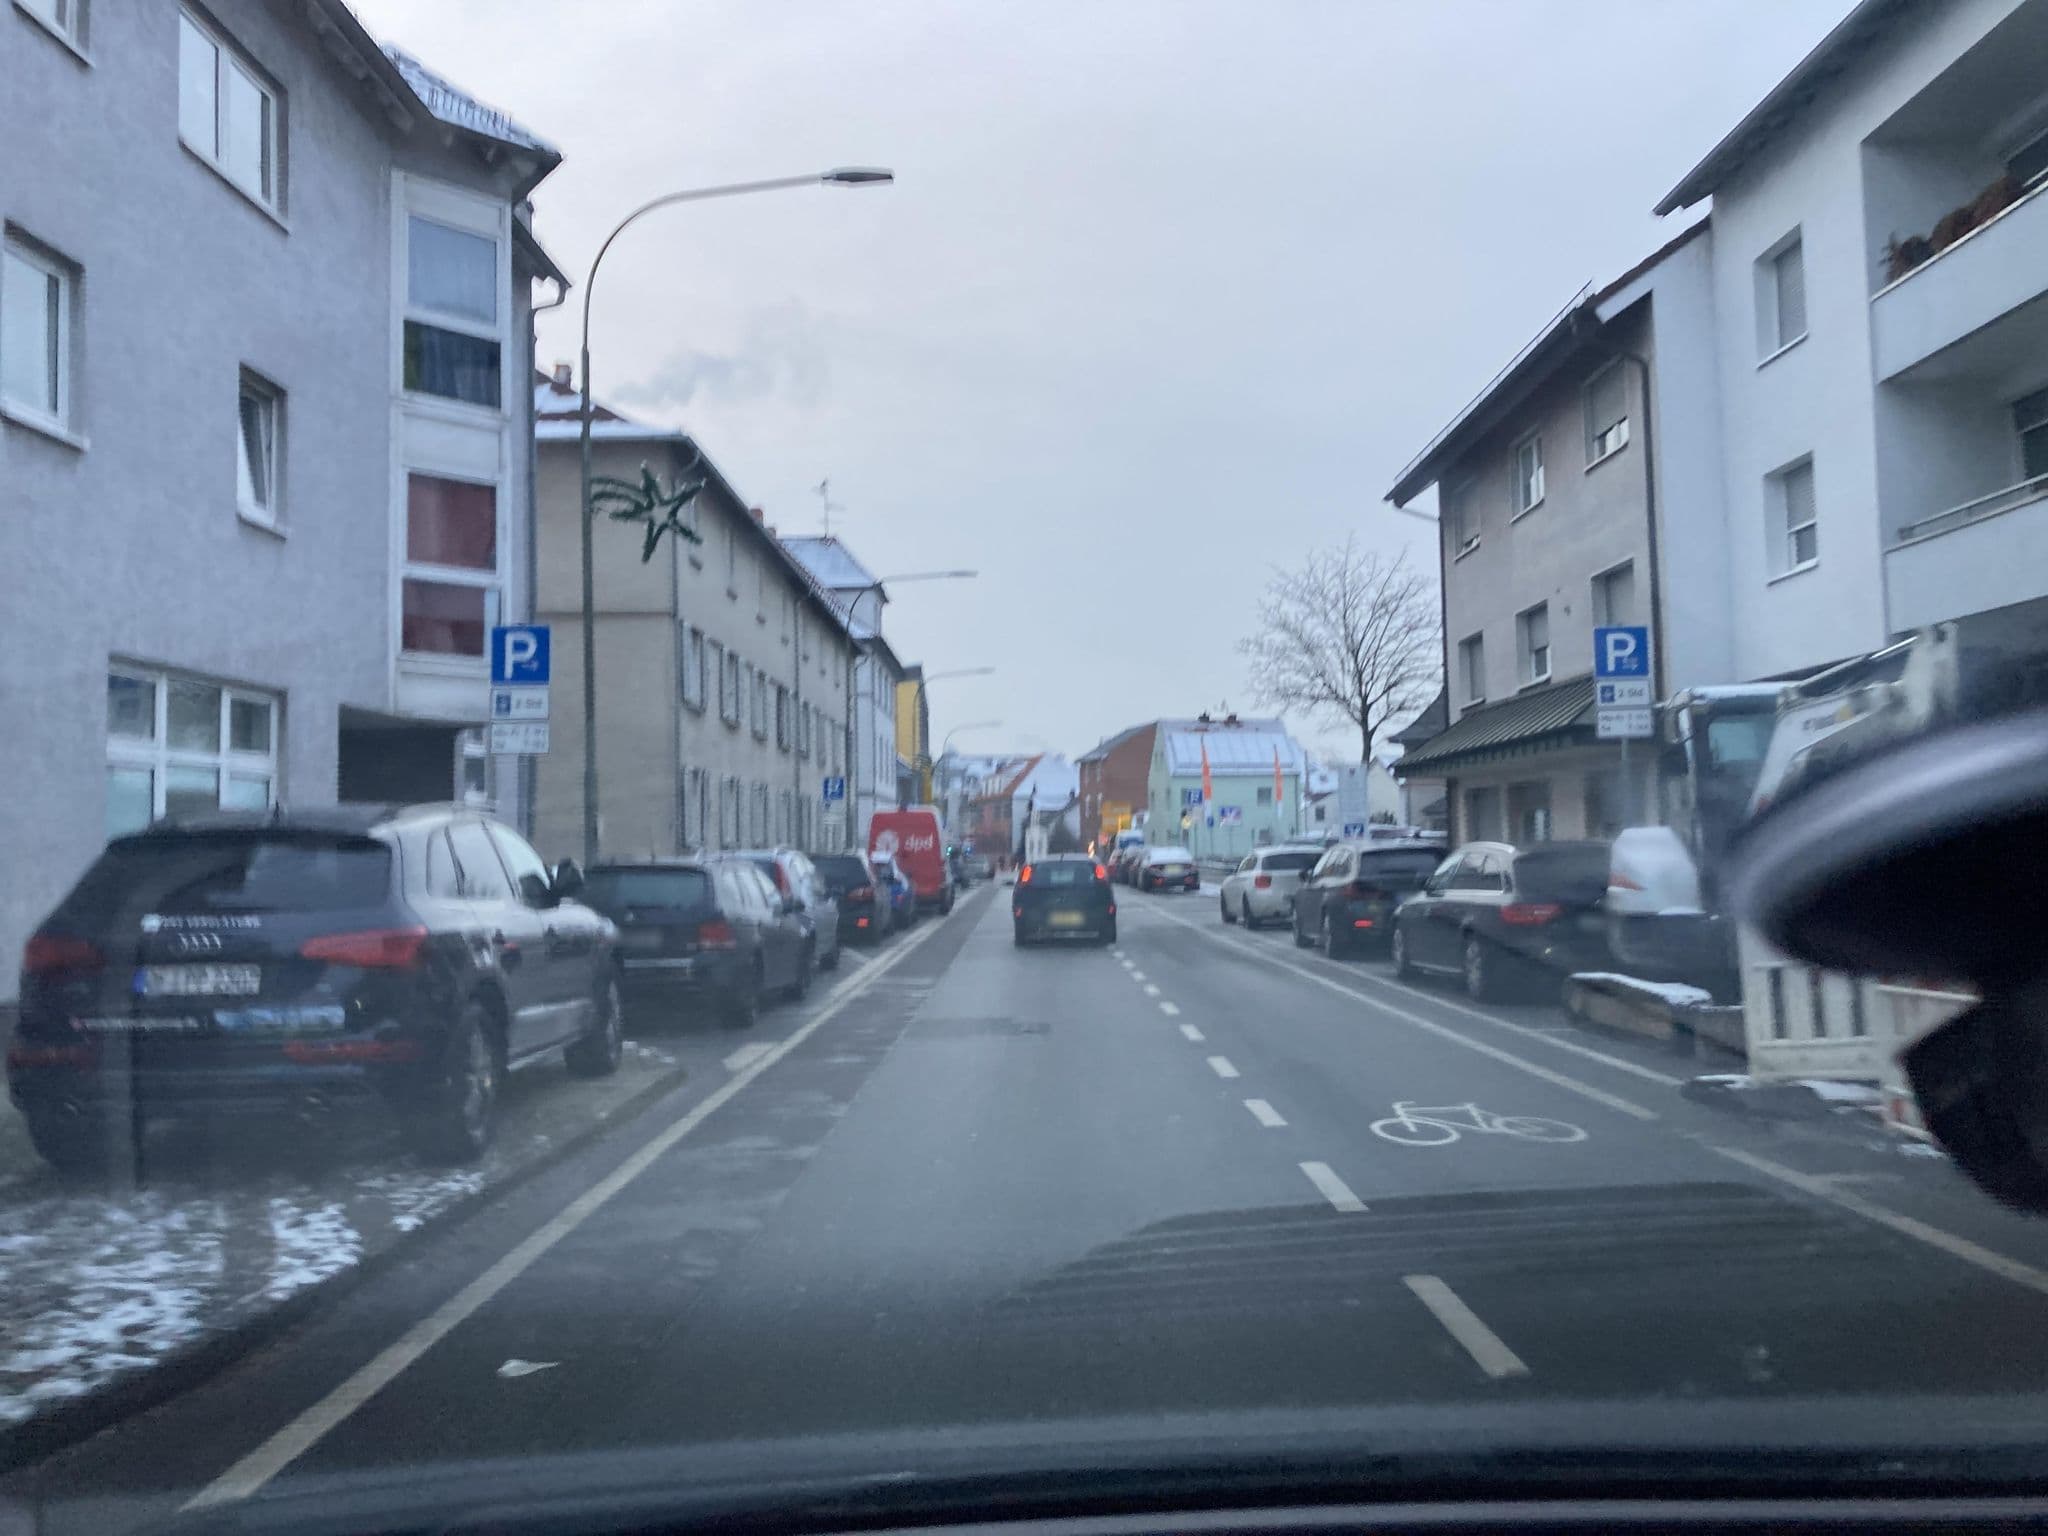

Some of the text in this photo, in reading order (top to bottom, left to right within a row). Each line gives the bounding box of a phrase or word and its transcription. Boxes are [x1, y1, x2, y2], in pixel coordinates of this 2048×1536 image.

[504, 631, 538, 679] P
[1606, 633, 1636, 672] P
[904, 833, 933, 852] dpd
